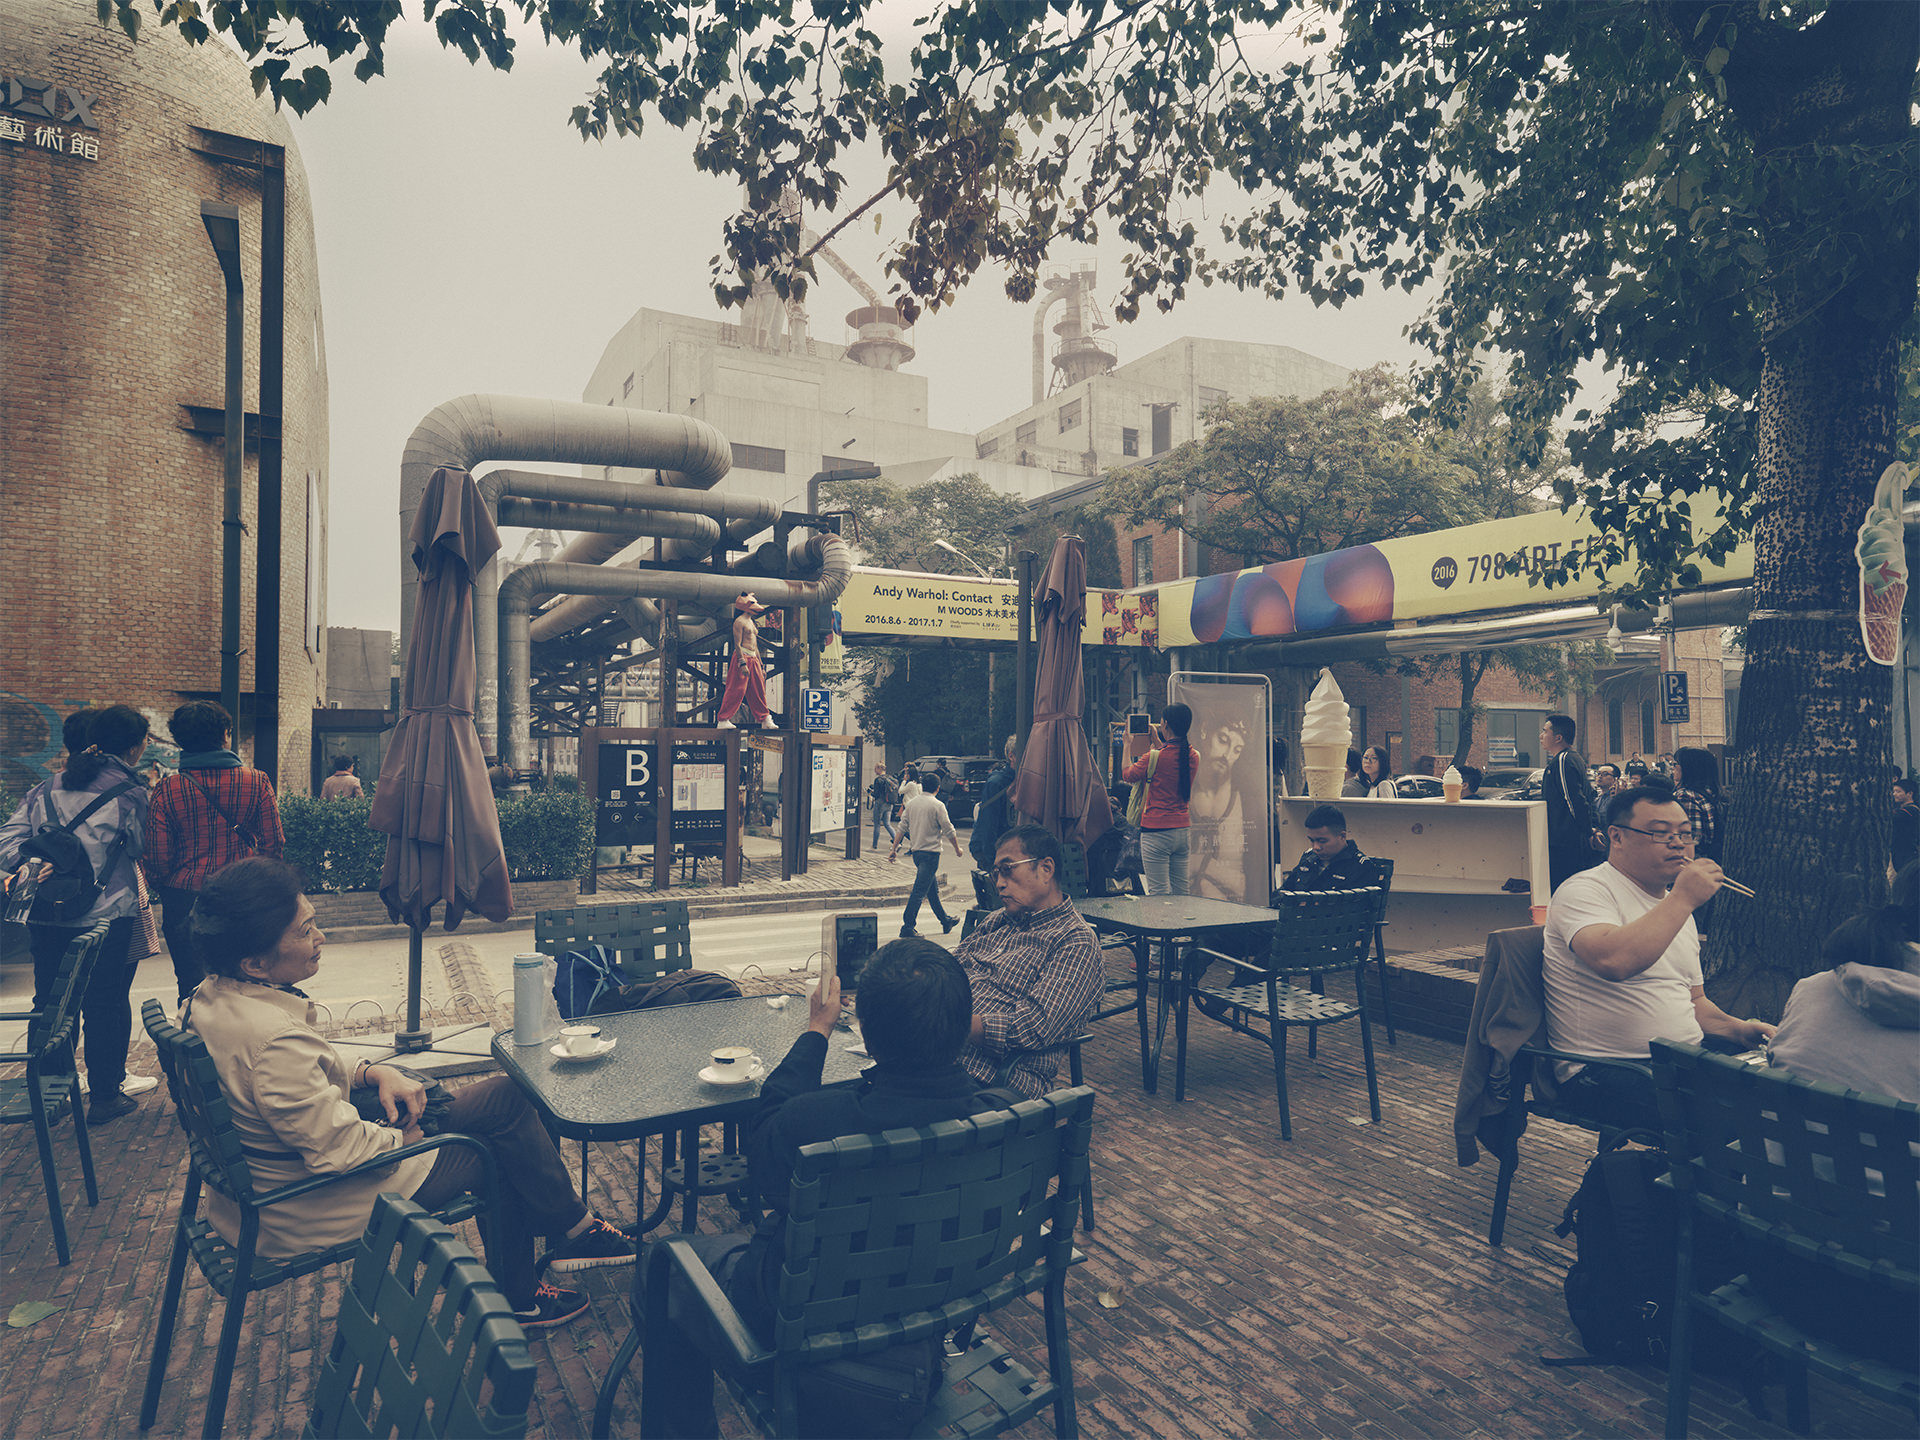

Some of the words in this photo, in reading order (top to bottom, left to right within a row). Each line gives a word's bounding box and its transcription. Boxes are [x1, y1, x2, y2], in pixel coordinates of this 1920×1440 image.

[0, 75, 99, 129] OX
[0, 115, 100, 161] 藝術館
[1433, 564, 1456, 581] 2016
[1467, 551, 1508, 584] 798
[1514, 542, 1562, 577] ART
[873, 584, 903, 600] Andy
[906, 587, 949, 600] Warhol:
[951, 591, 993, 604] Contact
[864, 614, 902, 625] 2016.8.6
[908, 617, 943, 628] 2017.1.7
[937, 605, 946, 614] M
[948, 606, 983, 617] WOODS
[985, 608, 1019, 619] 木木美术
[1669, 675, 1679, 694] P
[809, 691, 822, 708] P
[626, 749, 651, 787] B
